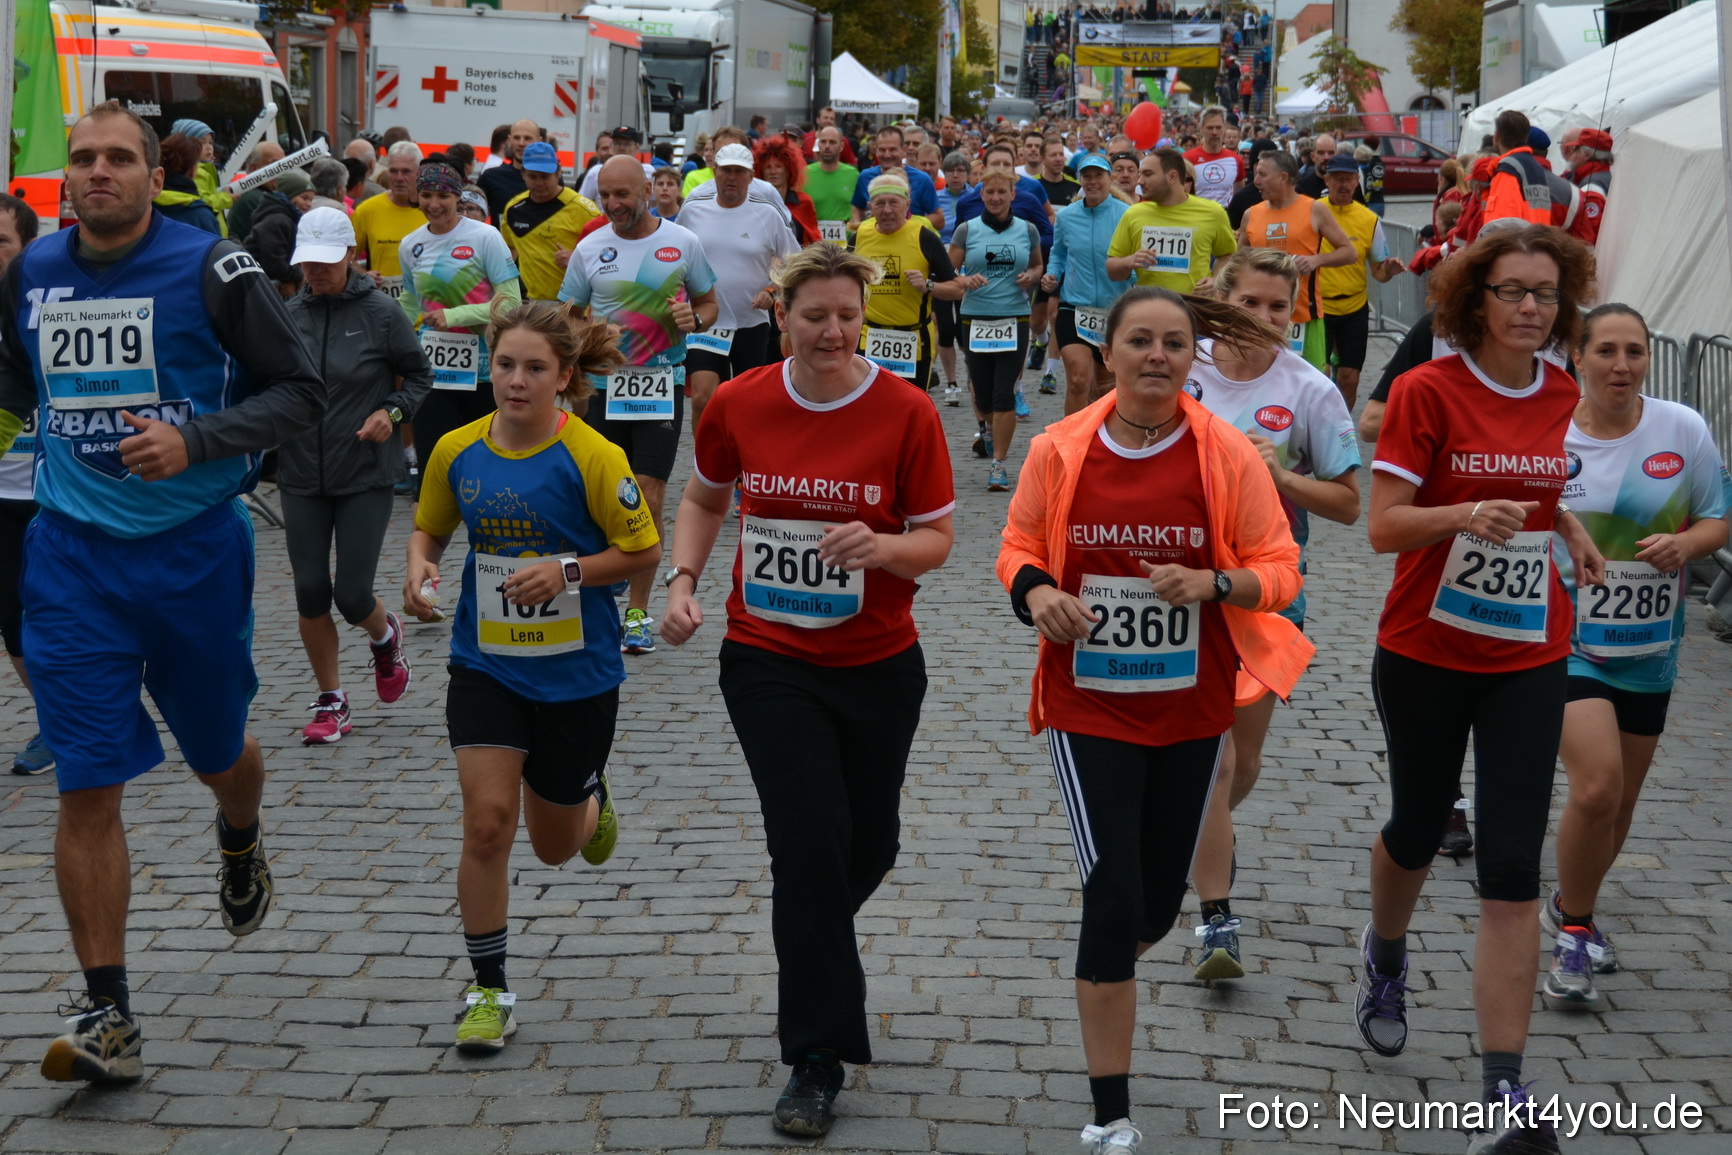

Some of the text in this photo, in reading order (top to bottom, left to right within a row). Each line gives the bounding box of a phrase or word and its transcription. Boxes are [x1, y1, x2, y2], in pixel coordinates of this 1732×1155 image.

[1121, 51, 1171, 63] START
[465, 67, 534, 81] Bayerisches
[464, 82, 497, 93] Rotes
[464, 96, 497, 107] Kreuz
[834, 100, 880, 111] Laufsport
[239, 145, 322, 190] bmw-laufsport.de
[658, 249, 679, 258] Hervis
[1146, 237, 1187, 255] 2110
[42, 311, 132, 323] PARTL Neumarkt
[51, 325, 143, 368] 2019
[871, 340, 913, 360] 2693
[424, 344, 472, 369] 2623
[656, 353, 670, 364] 16.
[75, 377, 120, 393] Simon
[614, 375, 669, 398] 2624
[623, 402, 657, 412] Thomas
[1260, 410, 1290, 426] Hervis
[14, 440, 35, 451] eter
[1451, 453, 1566, 477] NEUMARKT
[1648, 459, 1680, 472] Hervis
[741, 470, 859, 502] NEUMARKT
[1523, 480, 1550, 488] STARKE
[803, 502, 858, 514] STARKE STADT
[626, 511, 649, 528] PARTL
[746, 523, 824, 542] PARTL Neuma
[1066, 524, 1185, 546] NEUMARKT
[1459, 532, 1541, 553] PARTL Neumarkt
[478, 563, 506, 576] PARTL
[754, 542, 851, 588] 2604
[1454, 550, 1545, 599] 2332
[1082, 585, 1117, 599] PARTL
[767, 591, 832, 614] Veronika
[1589, 583, 1672, 619] 2286
[1468, 601, 1523, 625] Kerstin
[1087, 604, 1190, 648] 2360
[510, 628, 545, 643] Lena
[1604, 628, 1654, 643] Melanie
[1107, 658, 1165, 676] Sandra
